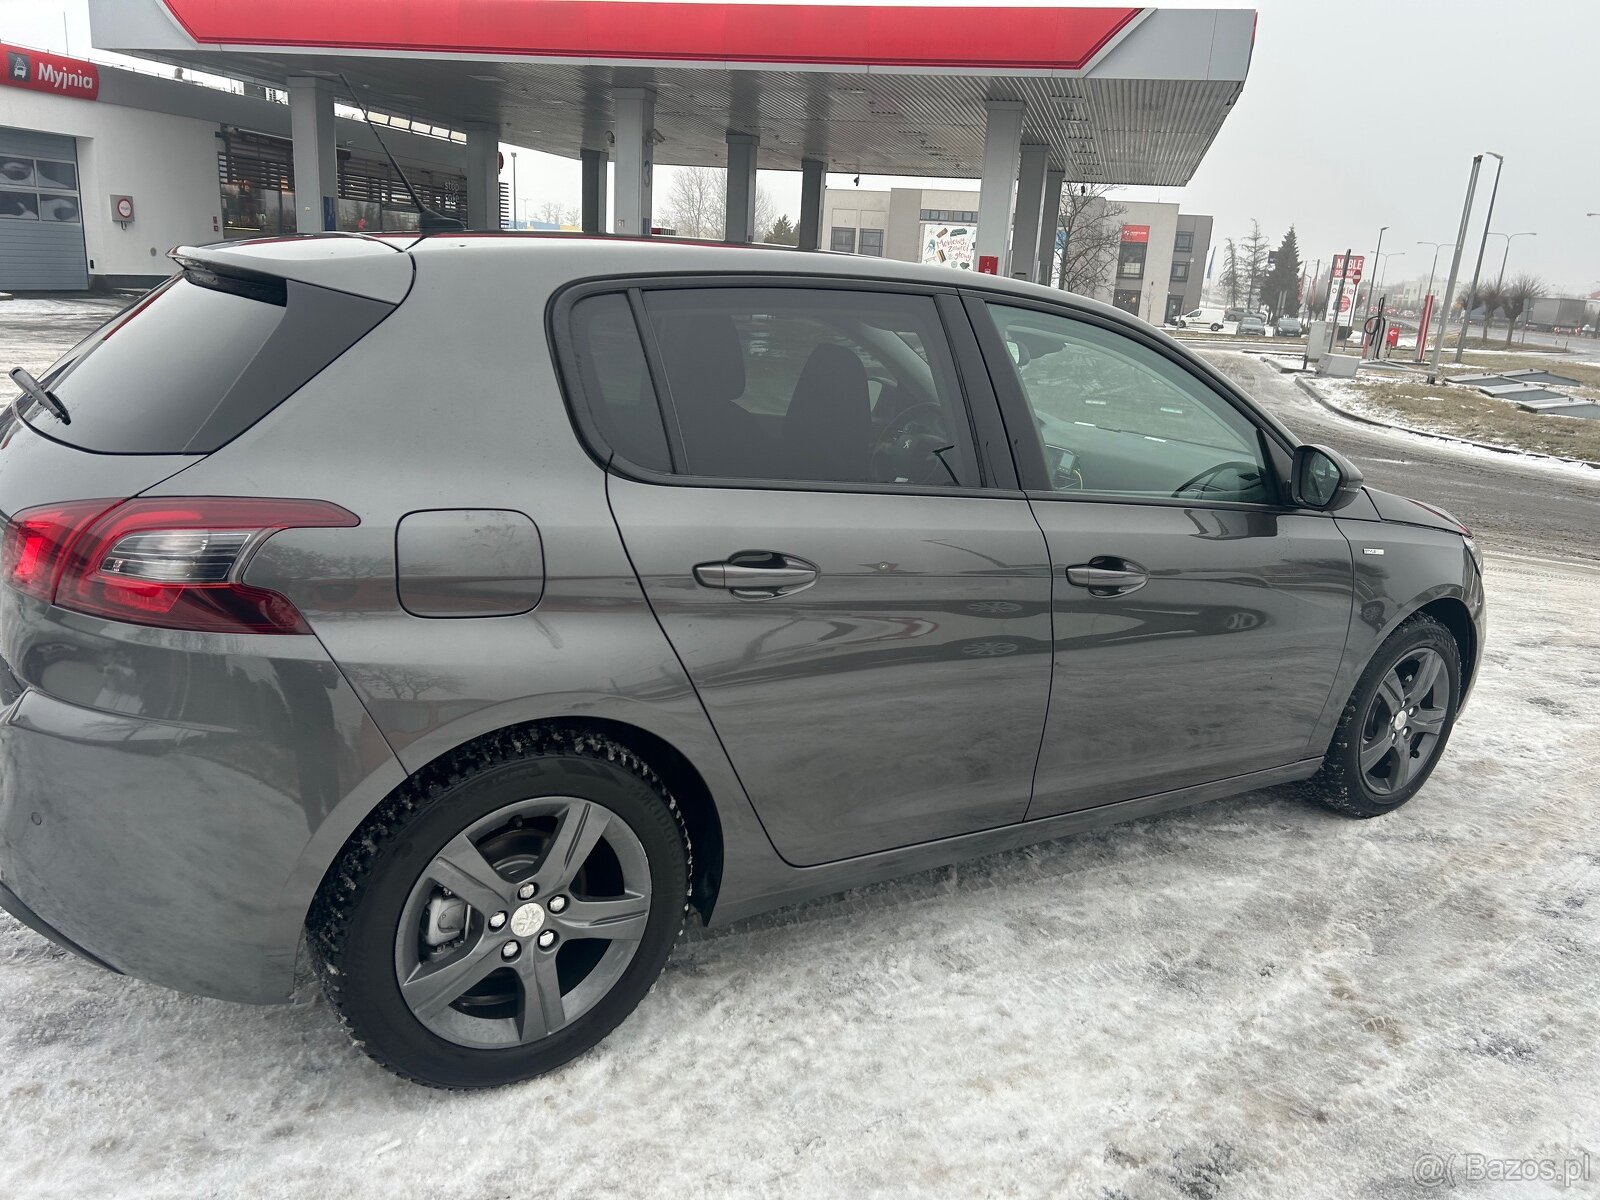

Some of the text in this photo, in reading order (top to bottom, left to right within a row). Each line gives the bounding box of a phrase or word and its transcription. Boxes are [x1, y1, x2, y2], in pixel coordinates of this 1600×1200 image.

[38, 62, 93, 90] Myjnia
[444, 181, 460, 194] stop
[1336, 258, 1363, 270] MBLE
